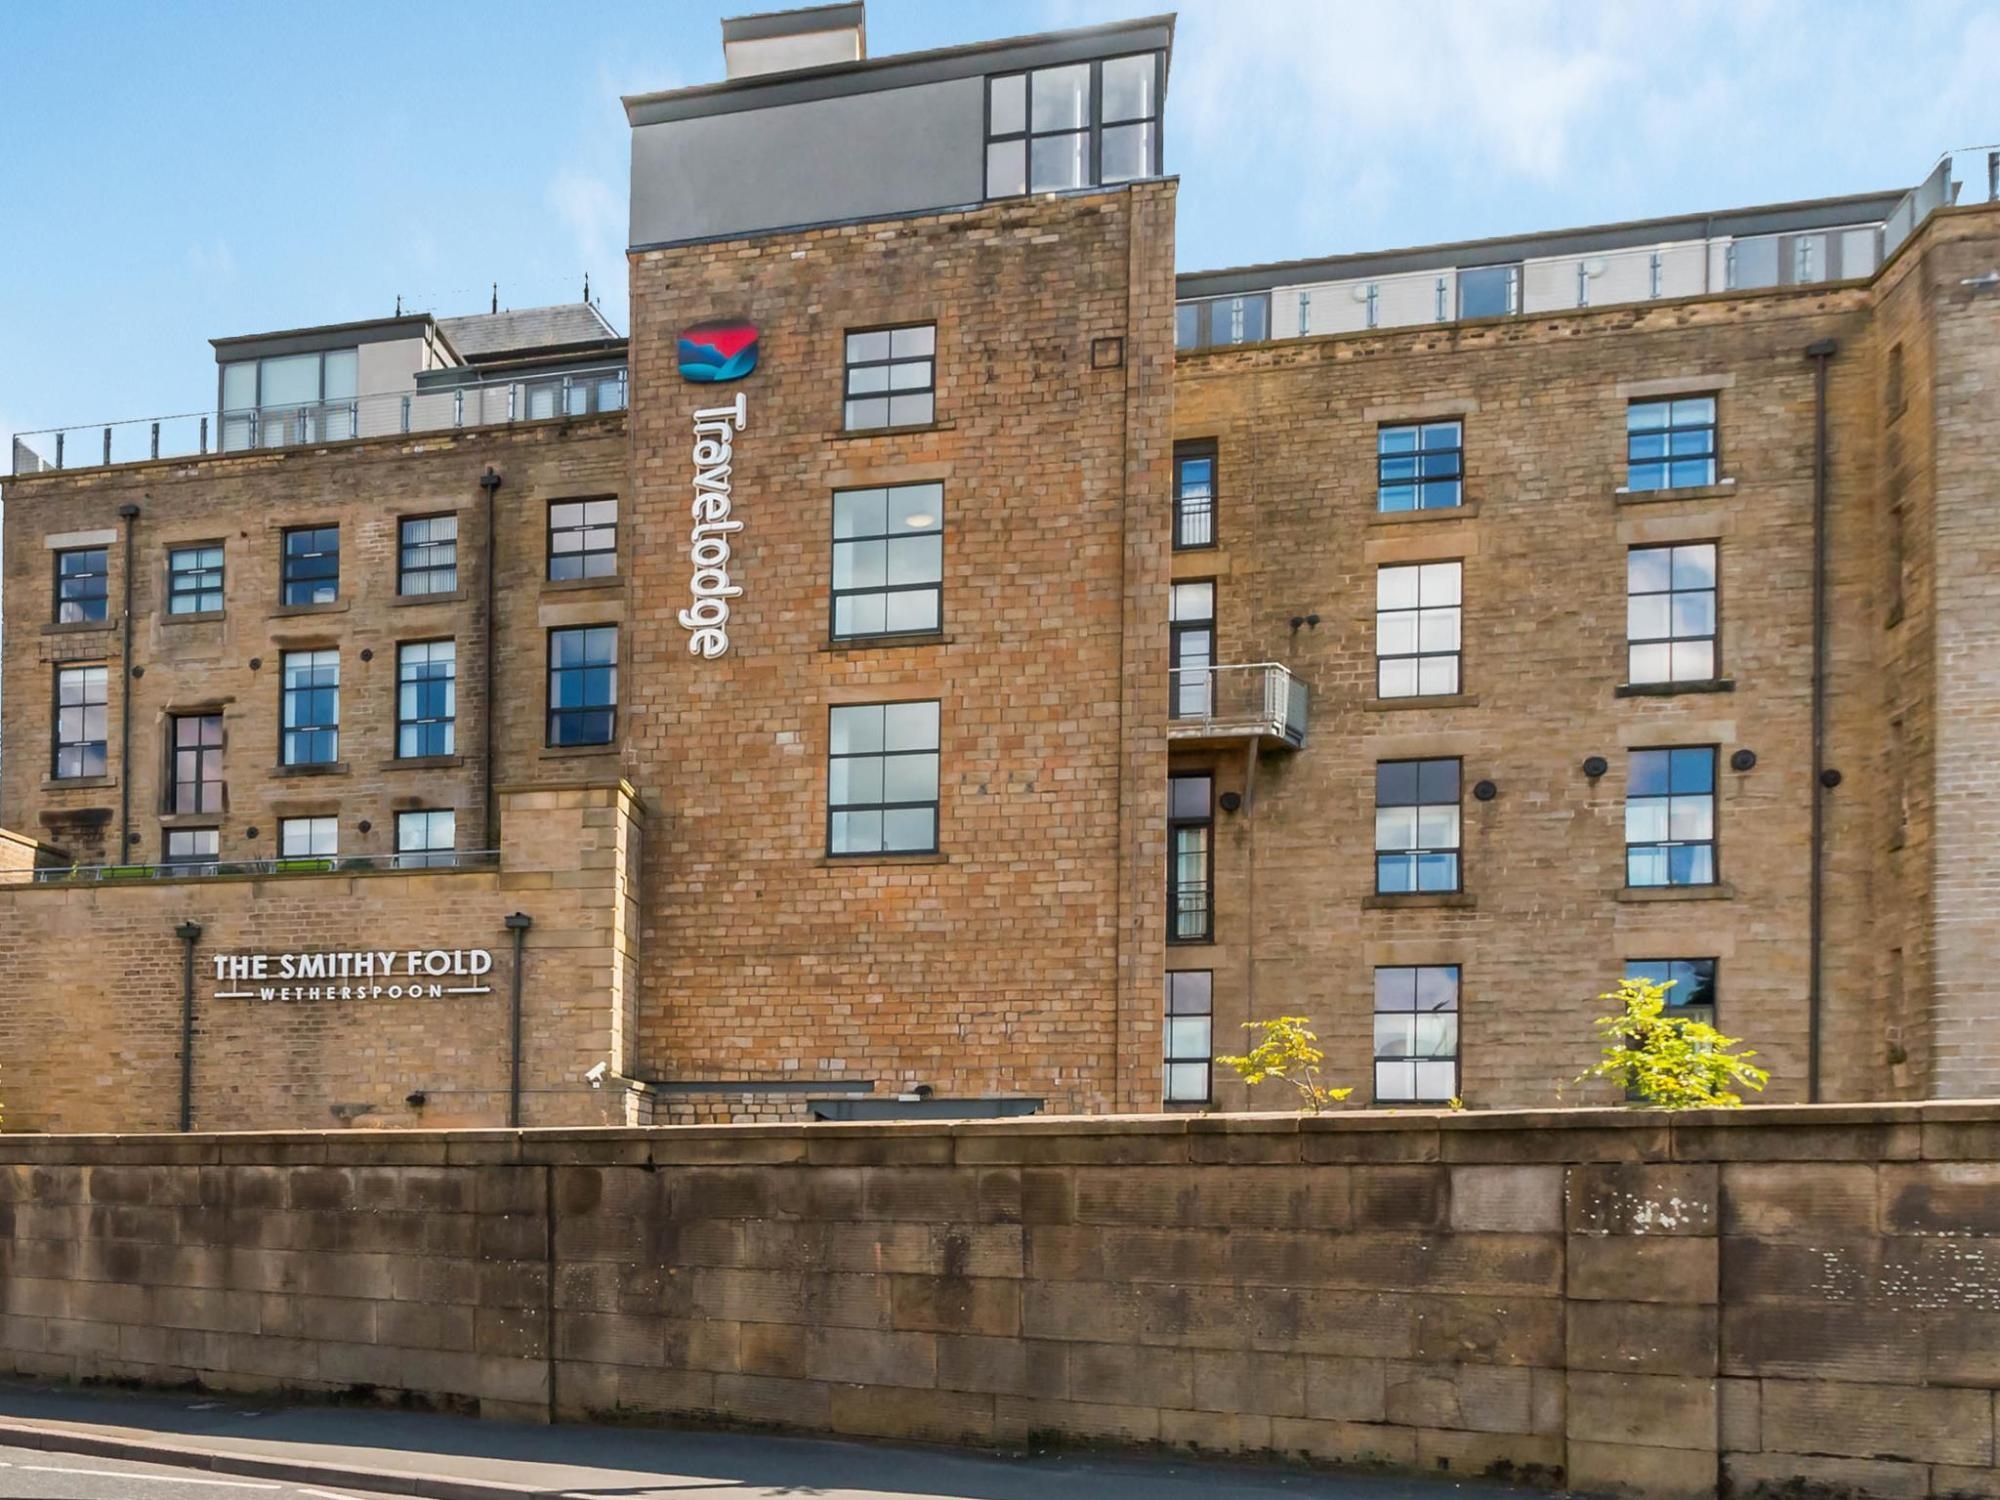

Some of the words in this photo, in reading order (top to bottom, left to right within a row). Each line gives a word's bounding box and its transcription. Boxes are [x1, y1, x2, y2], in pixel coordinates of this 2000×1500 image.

[678, 392, 747, 659] Travelodge
[214, 954, 268, 980] THE
[280, 951, 397, 979] SMITHY
[407, 949, 492, 977] FOLD
[260, 984, 443, 1001] WETHERSPOON
